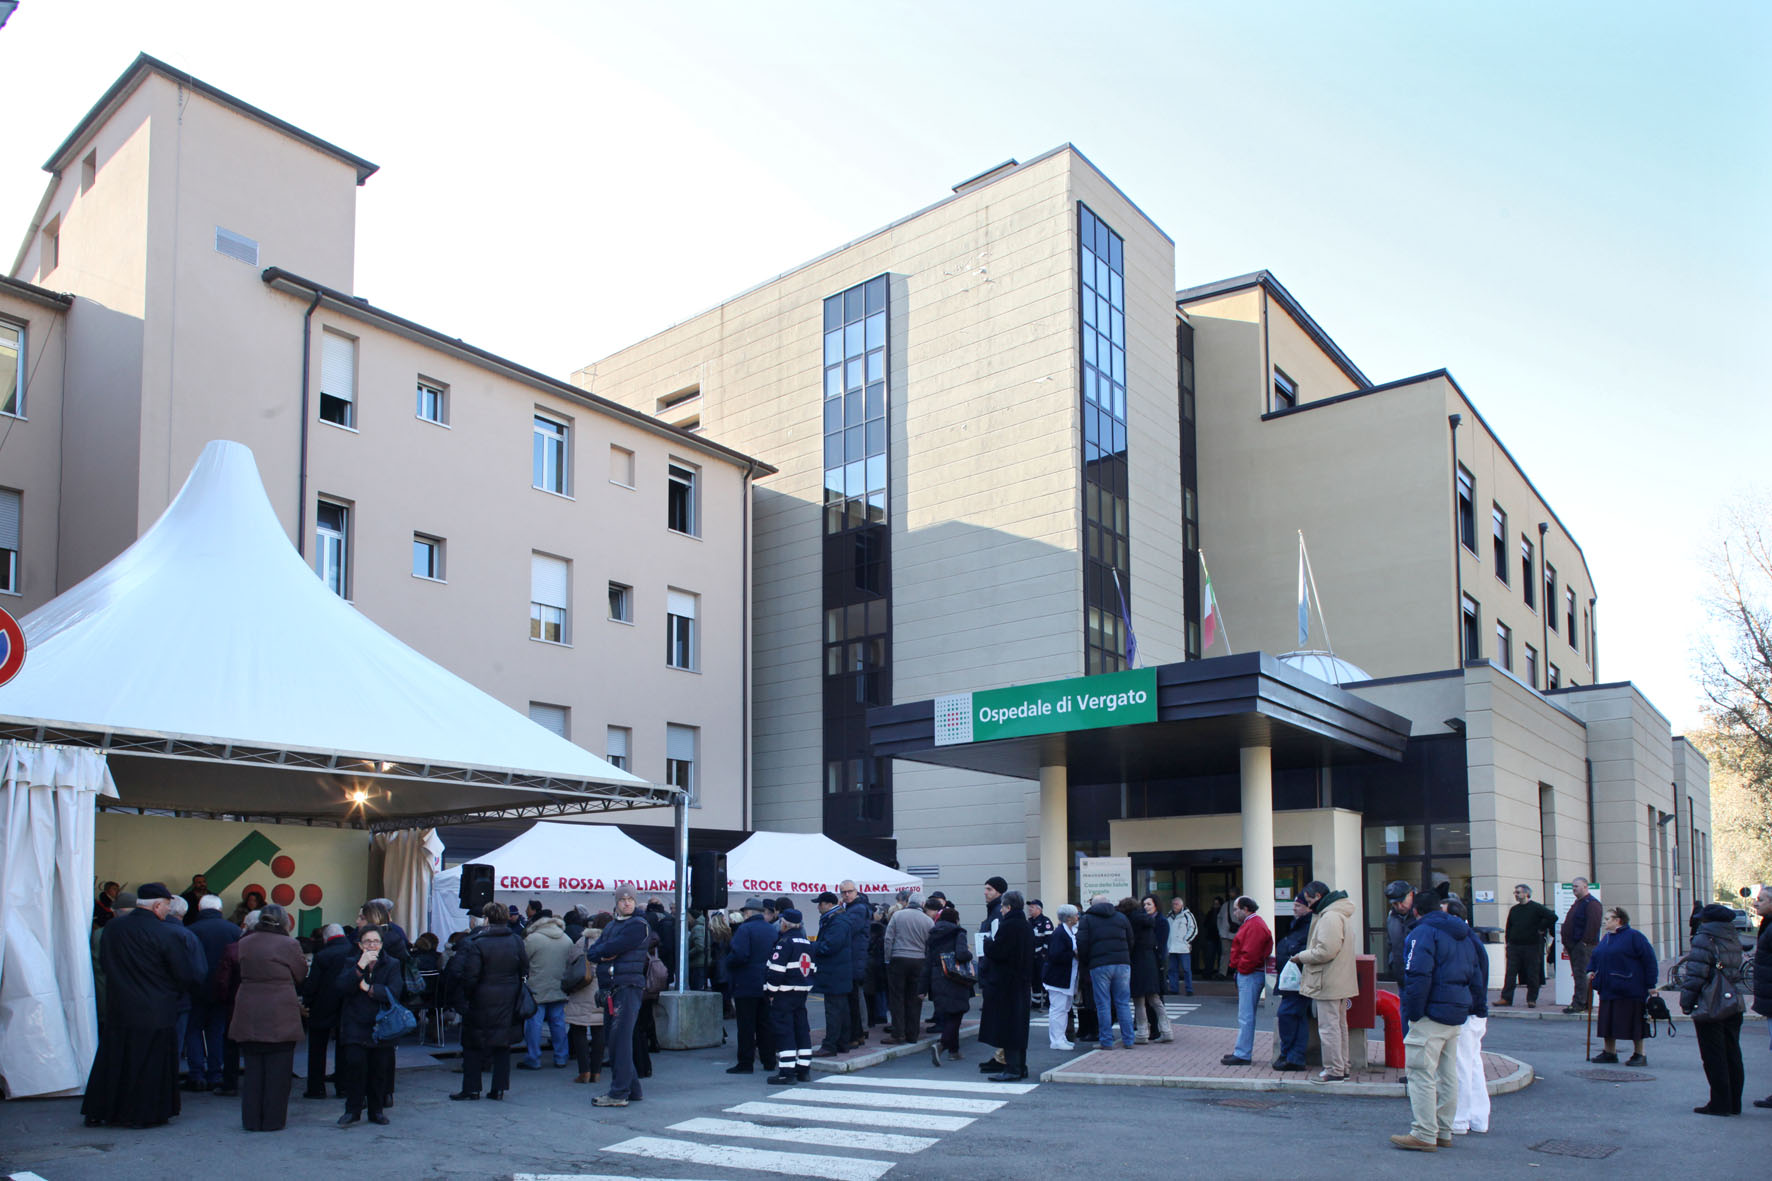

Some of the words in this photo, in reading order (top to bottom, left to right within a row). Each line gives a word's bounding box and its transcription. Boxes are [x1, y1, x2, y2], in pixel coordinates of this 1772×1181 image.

[979, 699, 1052, 724] Ospedale
[1056, 696, 1072, 713] di
[1077, 689, 1147, 712] Vergato
[500, 876, 550, 889] CROCE
[559, 877, 605, 890] ROSSA
[742, 879, 783, 892] CROCE
[791, 881, 827, 893] ROSSA
[834, 883, 890, 893] IIANA
